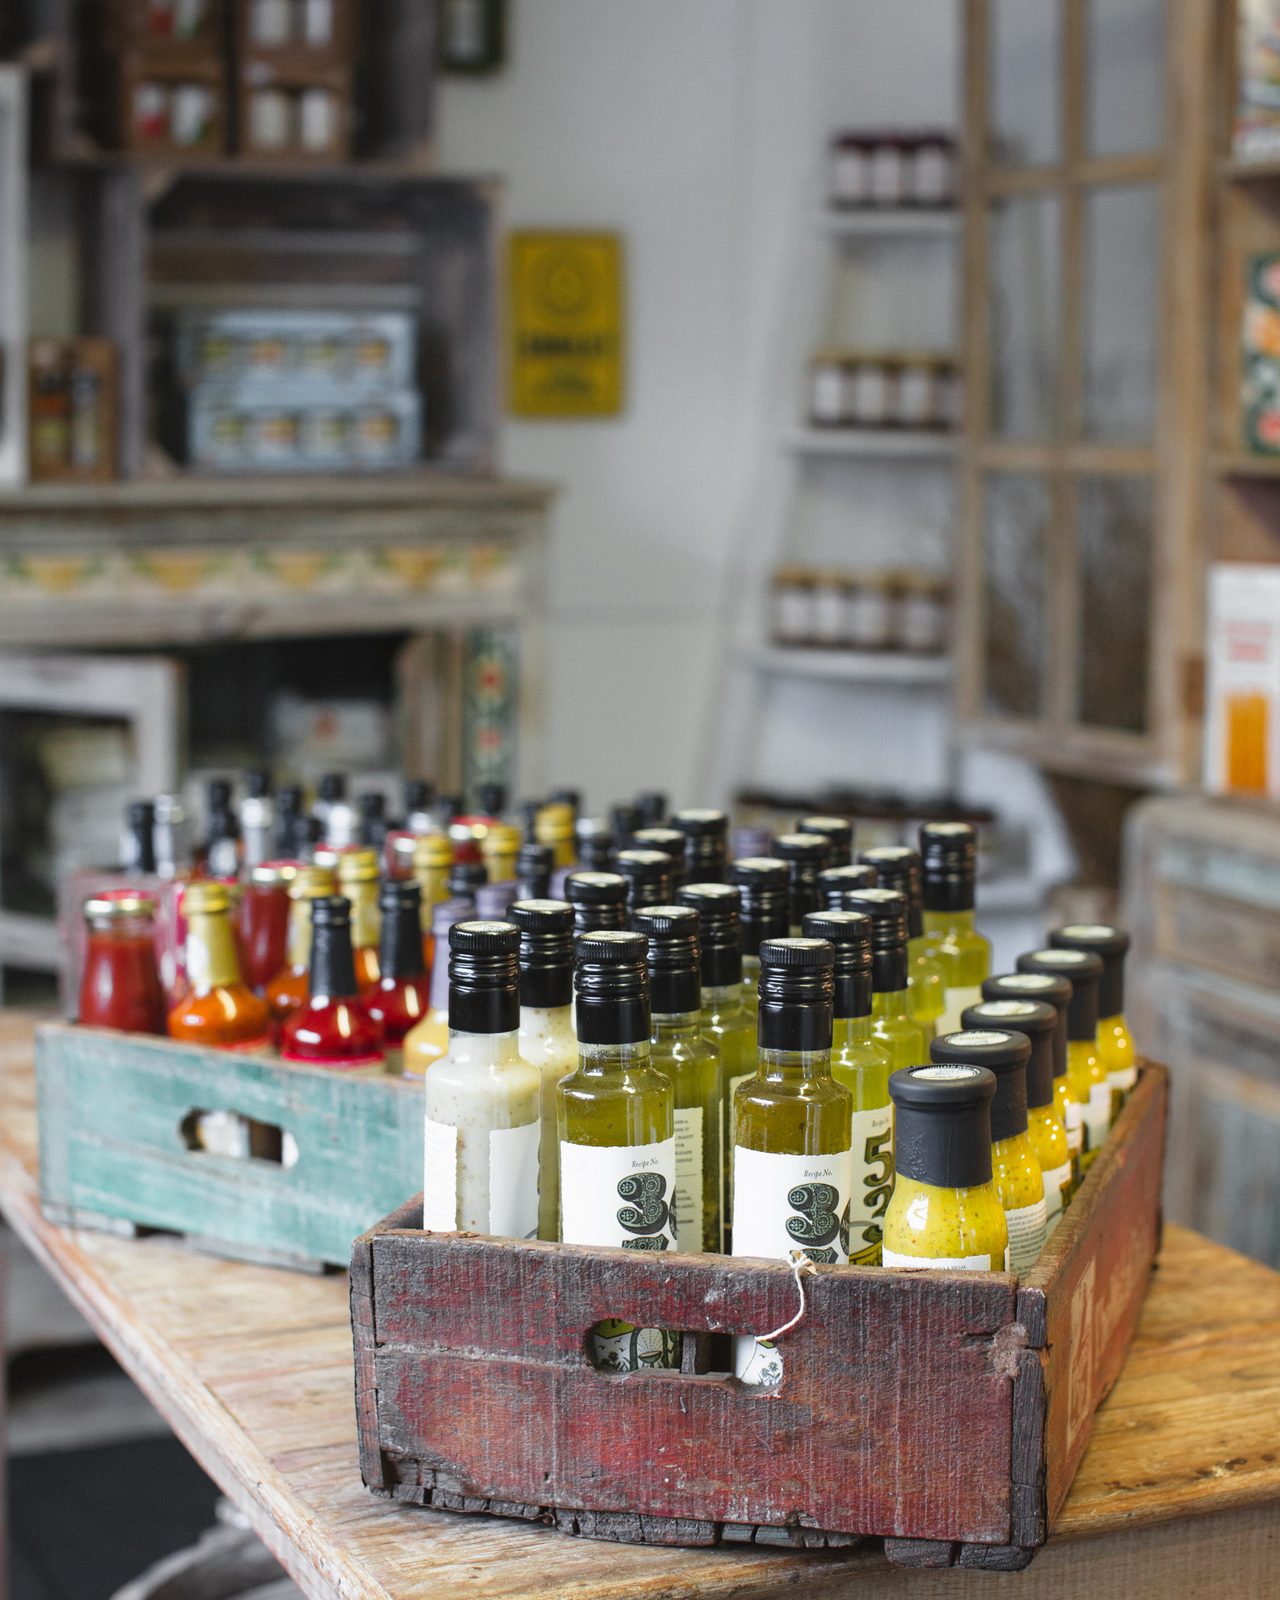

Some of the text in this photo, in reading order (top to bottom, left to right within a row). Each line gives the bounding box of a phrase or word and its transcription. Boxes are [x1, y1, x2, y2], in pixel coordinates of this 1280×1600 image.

[631, 1157, 659, 1169] Recipe No.
[803, 1168, 832, 1179] Recipe No.
[863, 1127, 892, 1187] 5
[616, 1172, 668, 1235] 3
[785, 1182, 839, 1247] 3
